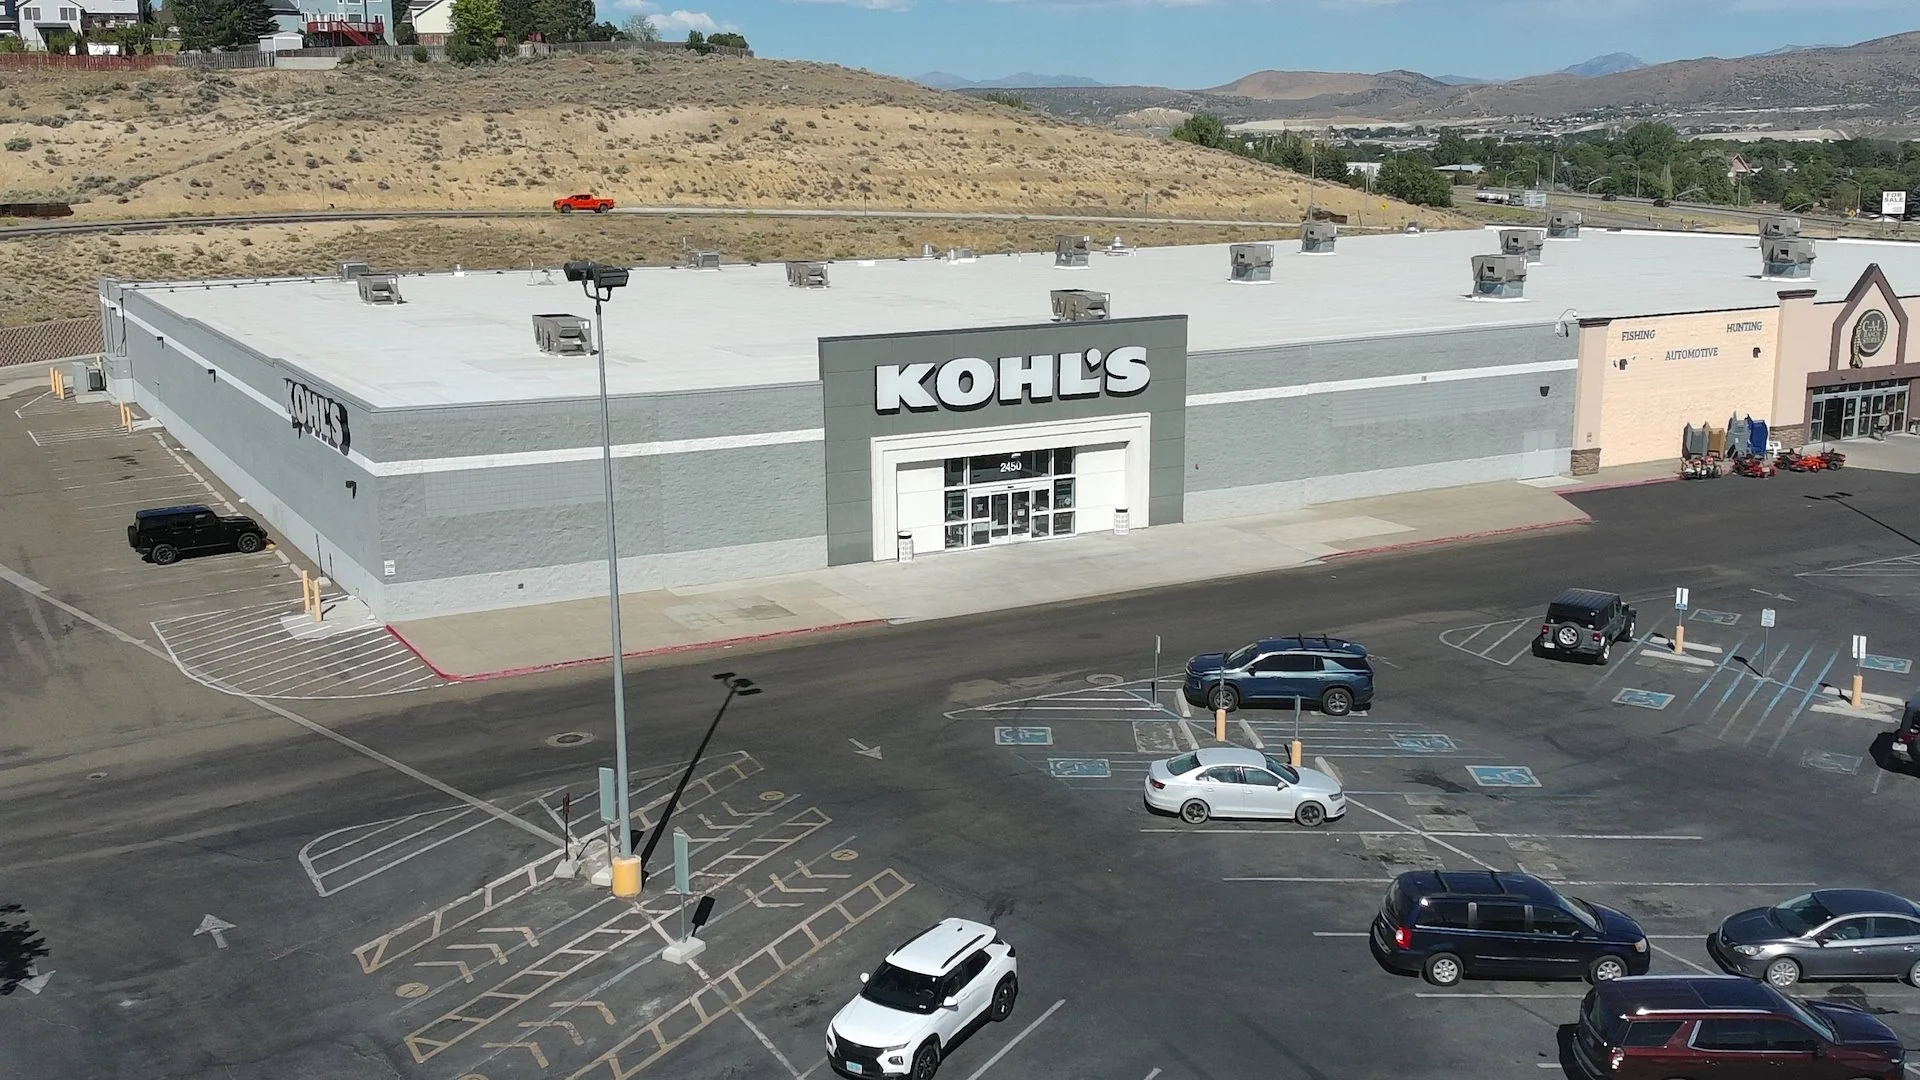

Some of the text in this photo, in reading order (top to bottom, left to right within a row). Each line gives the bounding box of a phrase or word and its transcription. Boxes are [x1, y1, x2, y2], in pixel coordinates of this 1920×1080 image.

[1726, 321, 1763, 333] HUNTING
[1621, 329, 1656, 342] FISHING
[1665, 346, 1719, 361] AUTOMOTIVE
[875, 346, 1150, 415] KOHL'S
[282, 378, 349, 452] KOHL'S
[1000, 460, 1022, 473] 2450
